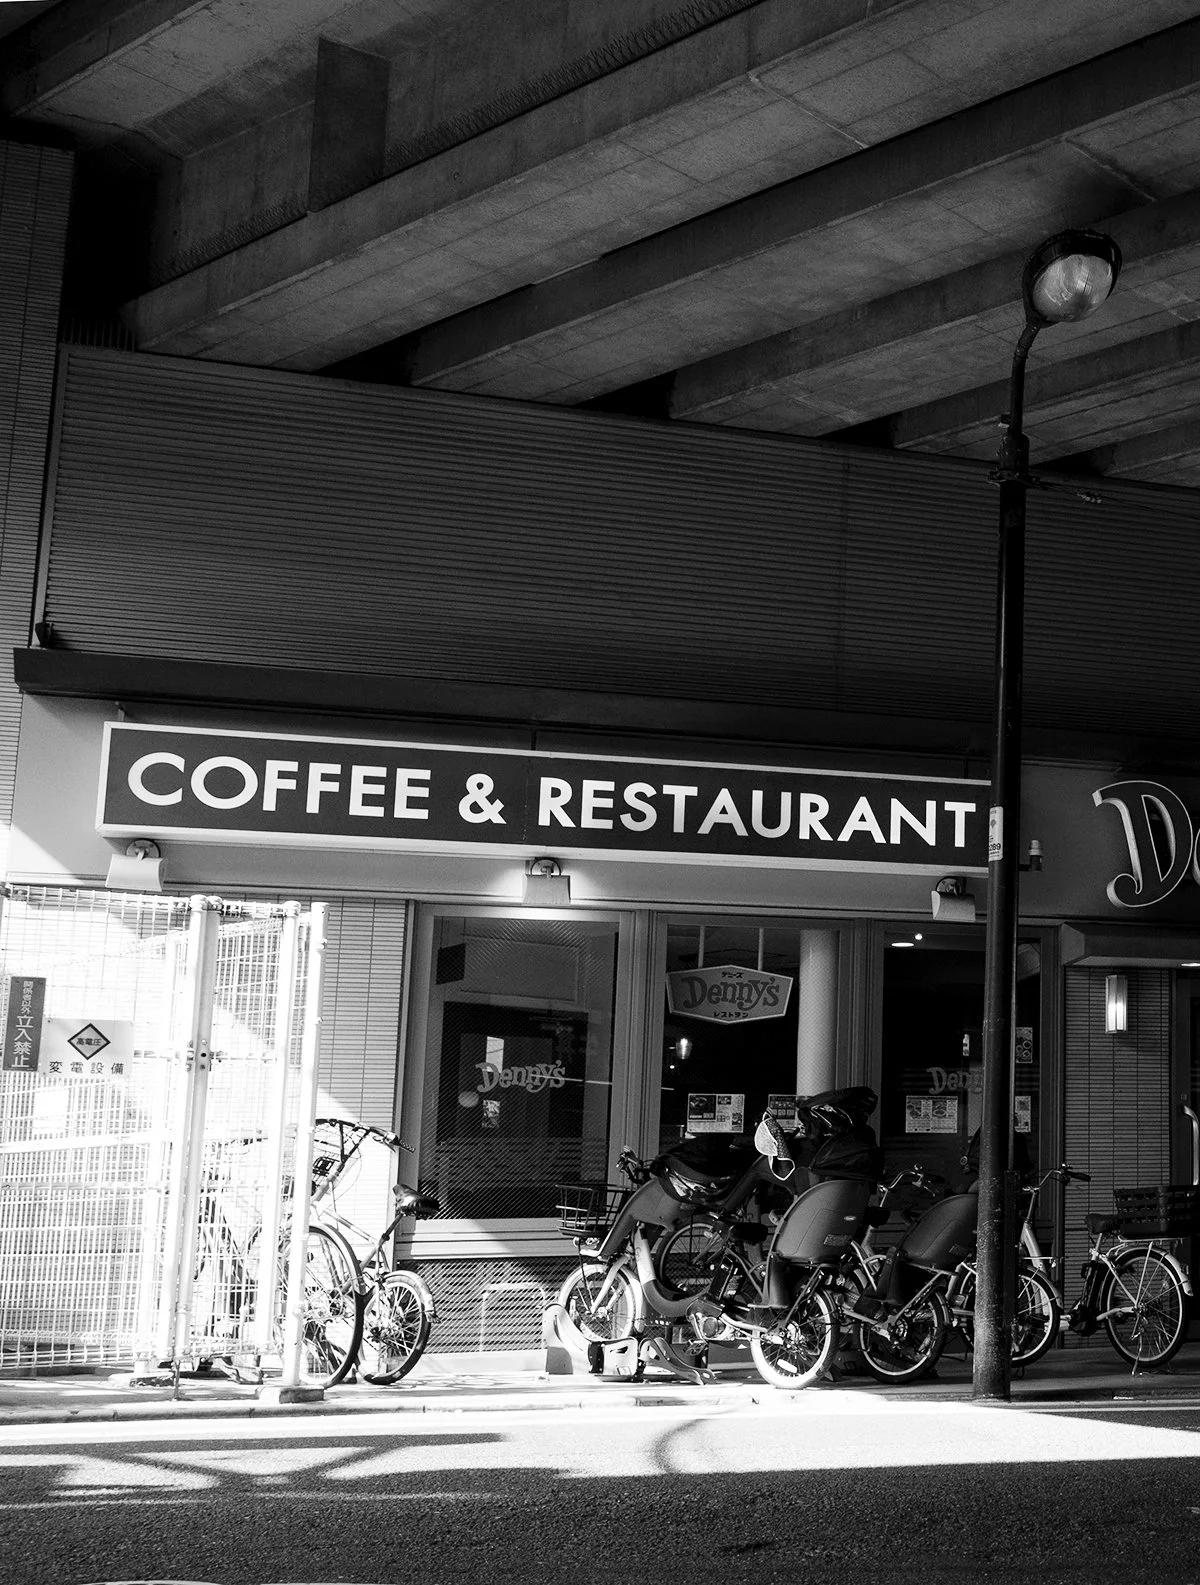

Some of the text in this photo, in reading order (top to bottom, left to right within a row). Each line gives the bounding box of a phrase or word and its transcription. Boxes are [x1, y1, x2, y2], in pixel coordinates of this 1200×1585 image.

[127, 752, 977, 849] COFFEE & RESTAURANT
[681, 976, 780, 1011] Denny's
[49, 1061, 124, 1075] 変電設備
[475, 1059, 566, 1093] Denny's
